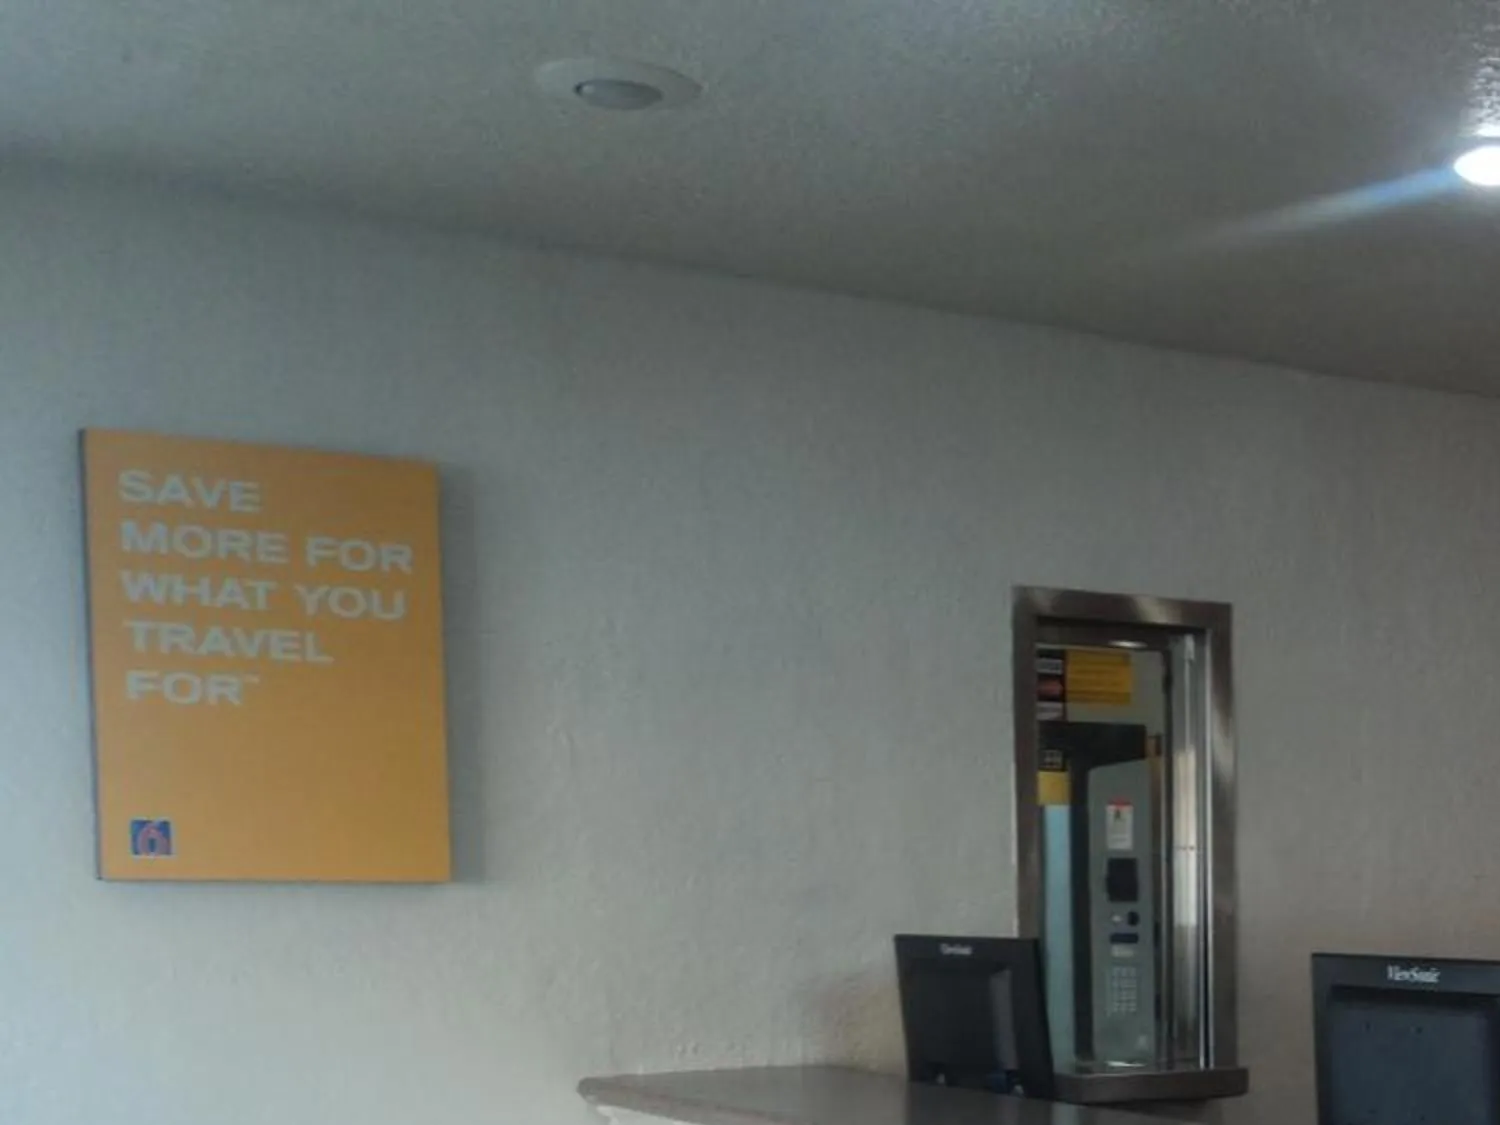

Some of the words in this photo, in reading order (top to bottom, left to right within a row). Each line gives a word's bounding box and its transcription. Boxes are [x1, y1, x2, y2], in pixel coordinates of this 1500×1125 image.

[118, 469, 261, 513] SAVE
[119, 520, 289, 564] MORE
[305, 537, 412, 573] FOR
[120, 570, 277, 611] WHAT
[294, 584, 407, 621] YOU
[122, 620, 334, 664] TRAVEL
